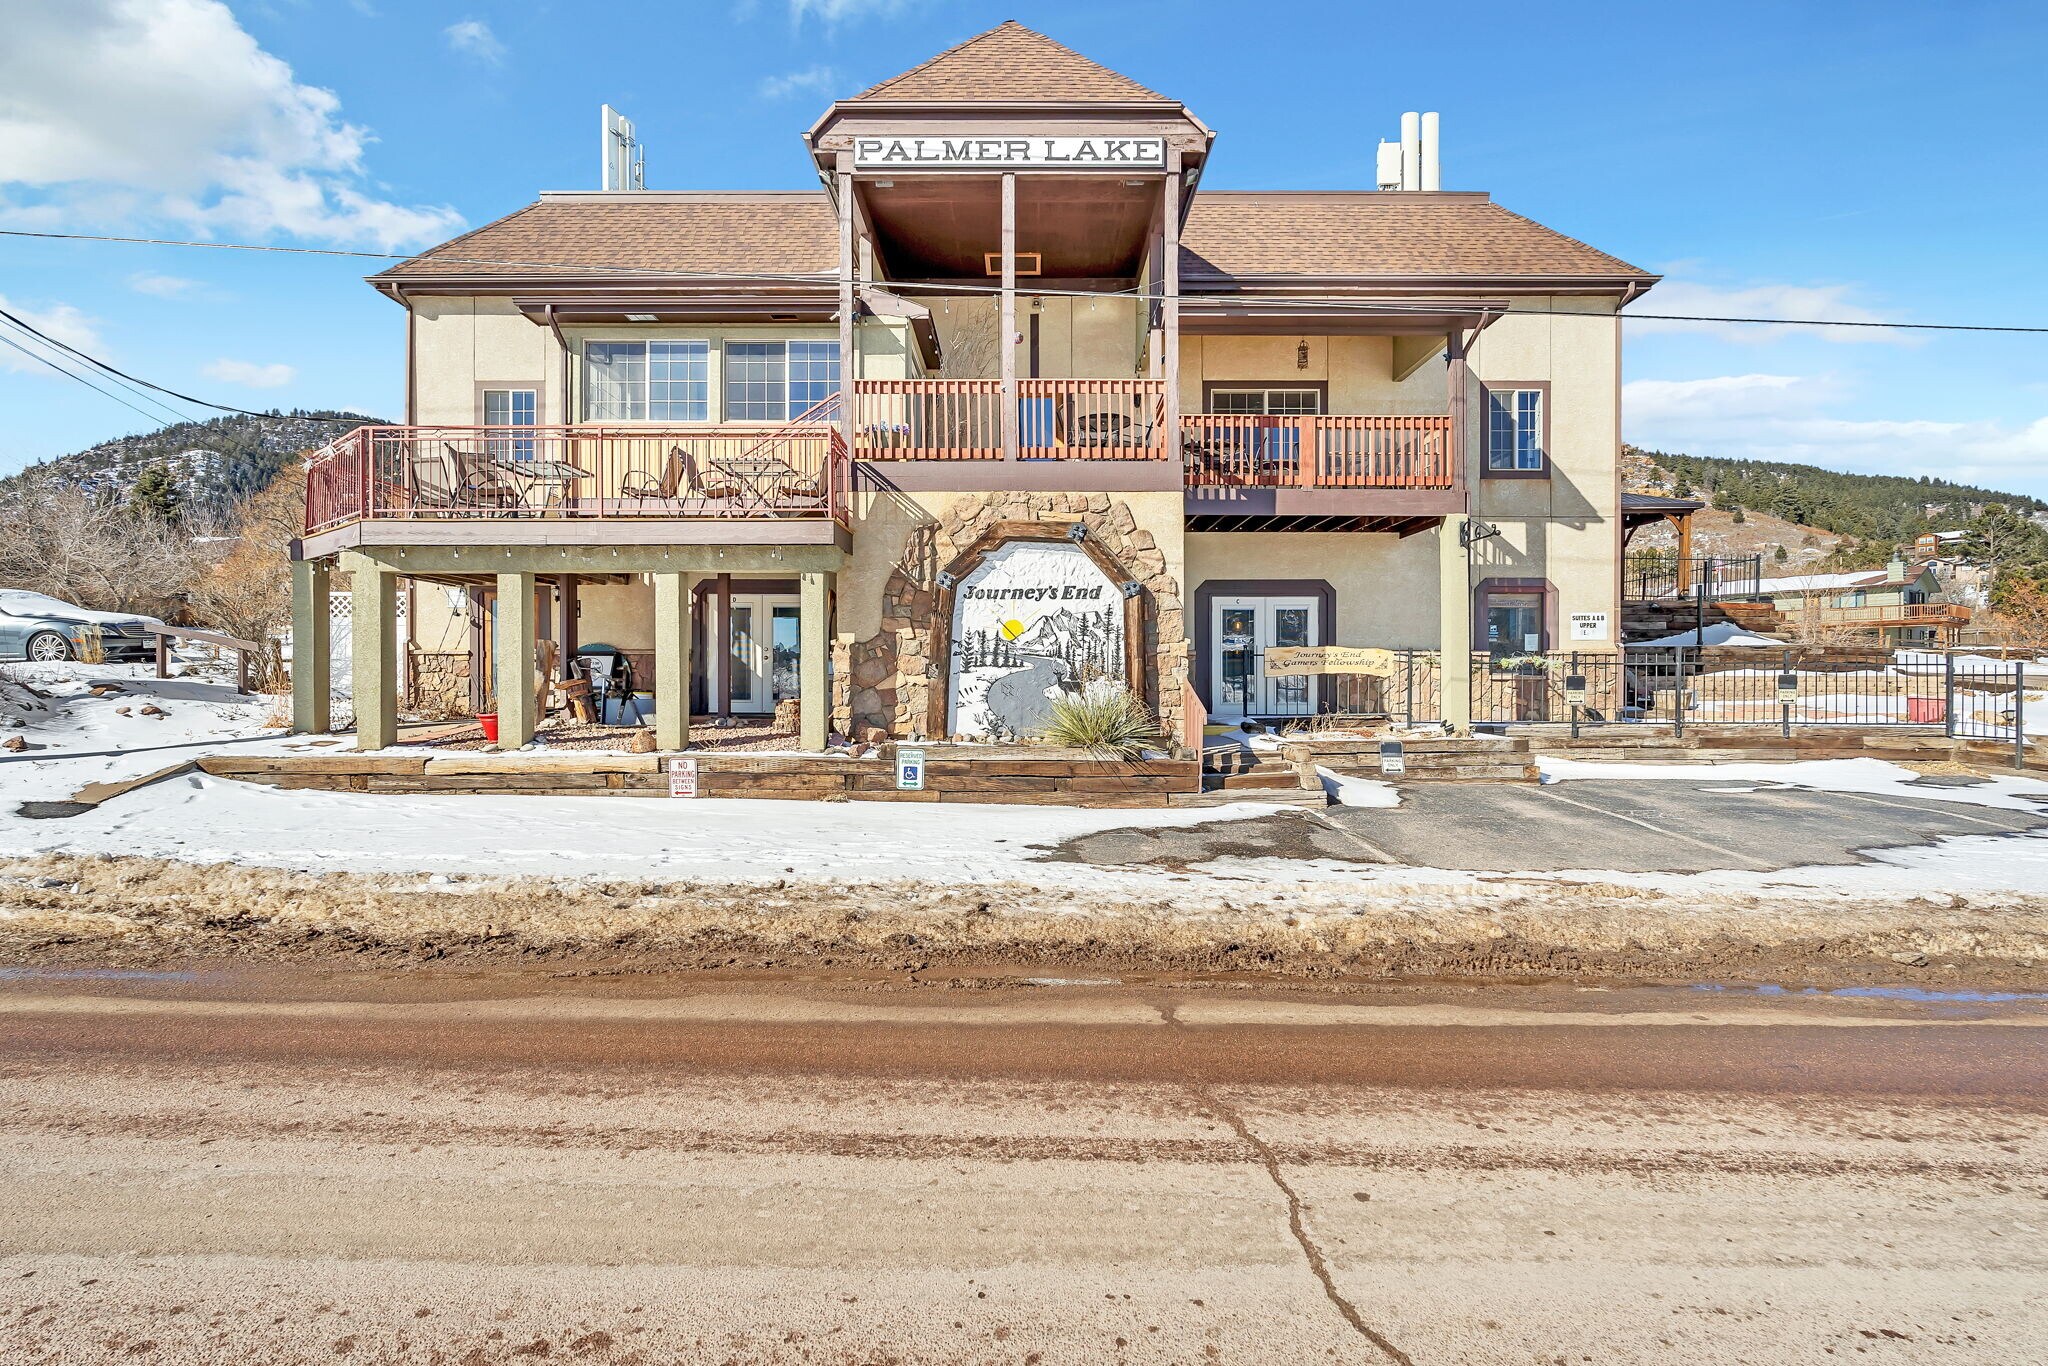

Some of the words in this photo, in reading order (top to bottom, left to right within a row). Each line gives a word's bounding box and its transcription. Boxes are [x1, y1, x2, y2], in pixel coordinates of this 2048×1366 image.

[858, 140, 1030, 161] PALMER
[1045, 140, 1160, 161] LAKE
[963, 585, 1058, 602] Journey's
[1061, 585, 1103, 600] End
[1294, 651, 1340, 659] Journey's
[1283, 659, 1318, 667] Gamers
[1320, 659, 1375, 667] Fellowship
[678, 761, 688, 769] NO
[671, 770, 695, 778] PARKING
